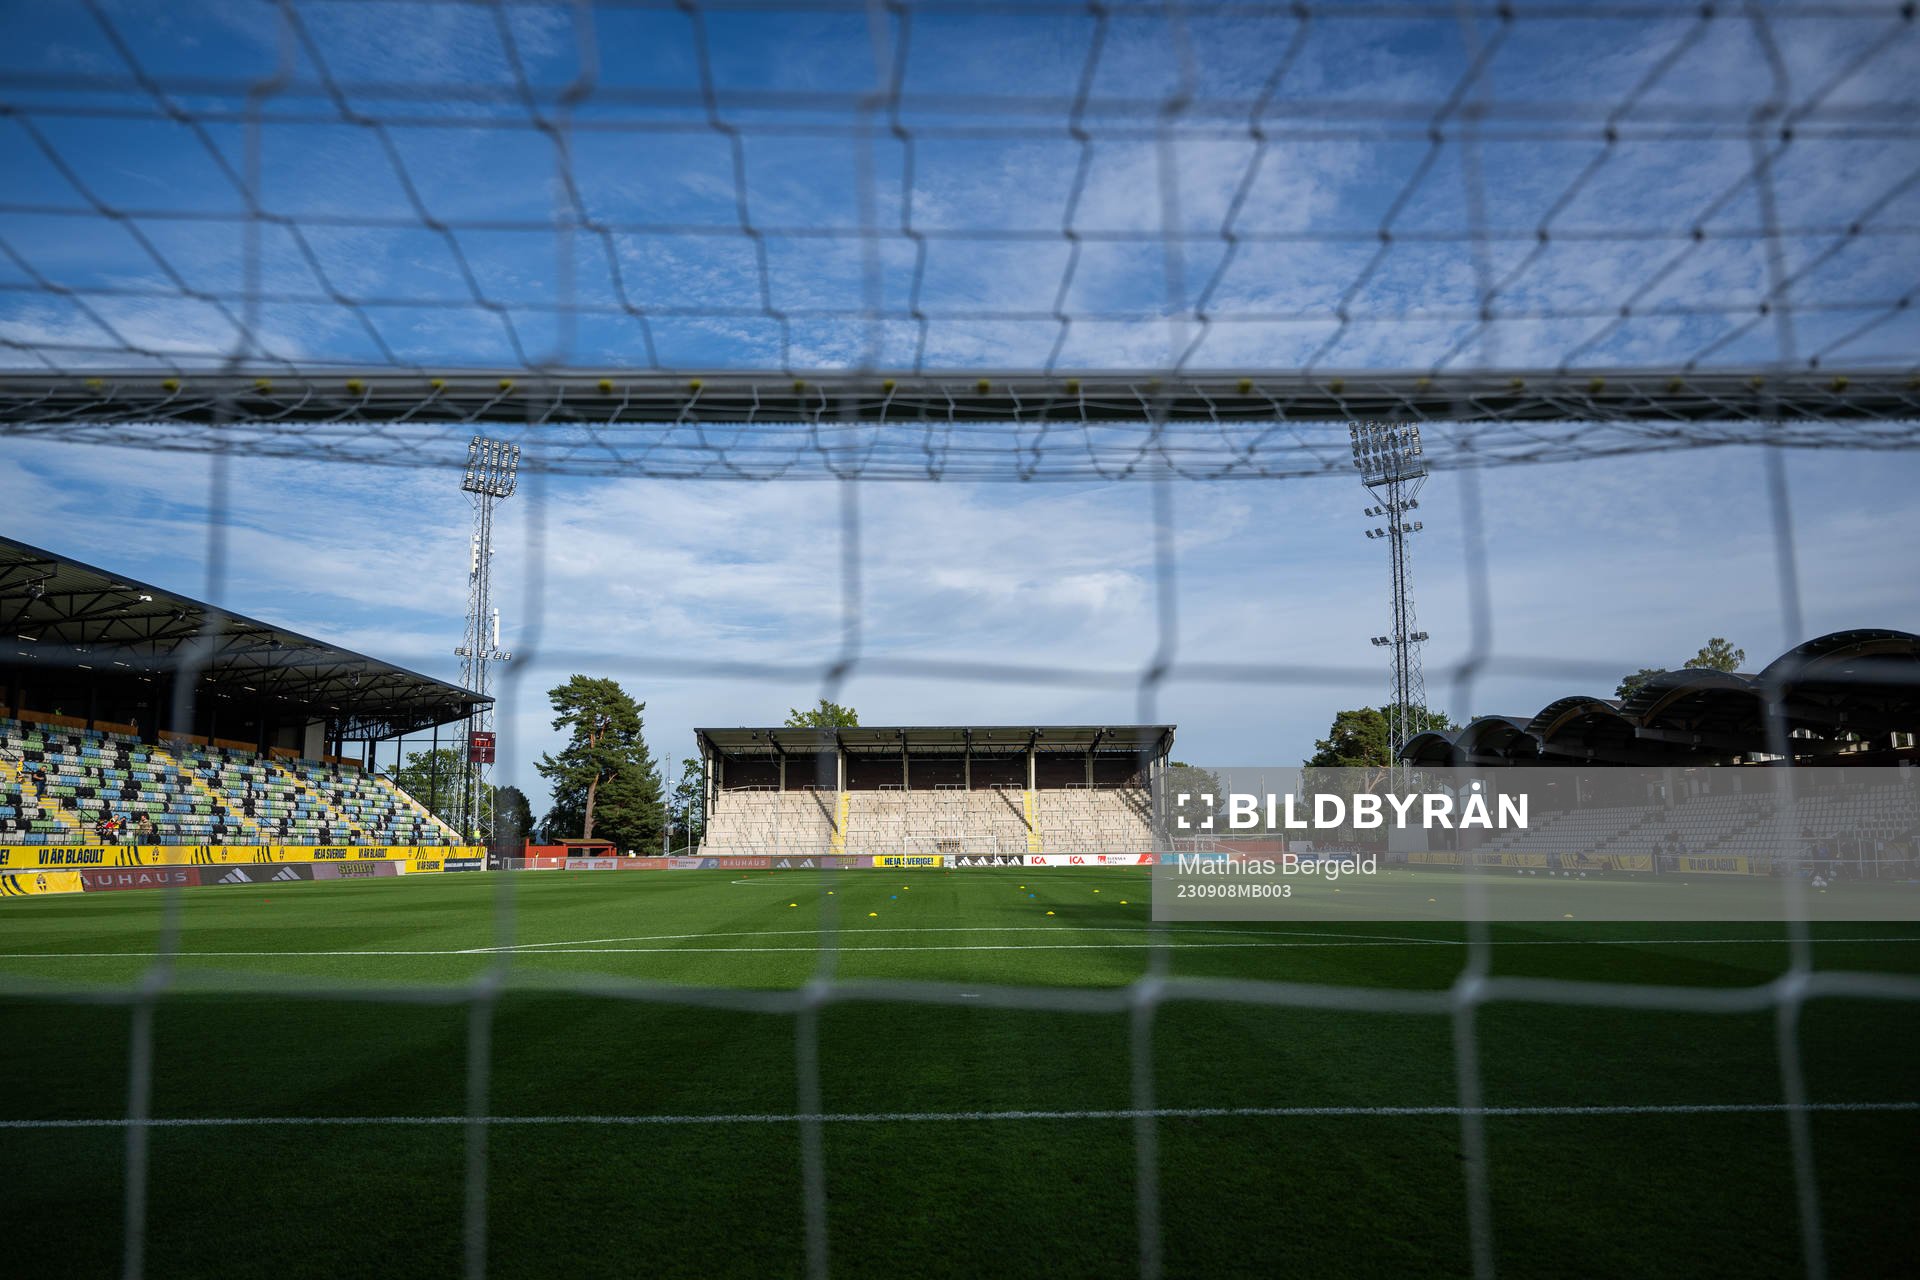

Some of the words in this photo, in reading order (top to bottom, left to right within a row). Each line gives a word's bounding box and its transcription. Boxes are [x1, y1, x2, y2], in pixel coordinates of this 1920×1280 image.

[39, 849, 49, 864] VI
[50, 848, 64, 864] ÄR
[66, 848, 104, 864] BLÅGULT
[314, 848, 326, 859] HEJA
[723, 859, 767, 867] BAUHAUS
[902, 857, 934, 865] SVERIGE!
[1031, 857, 1047, 865] ICA
[1070, 856, 1085, 864] ICA
[80, 871, 188, 886] AUHAUS
